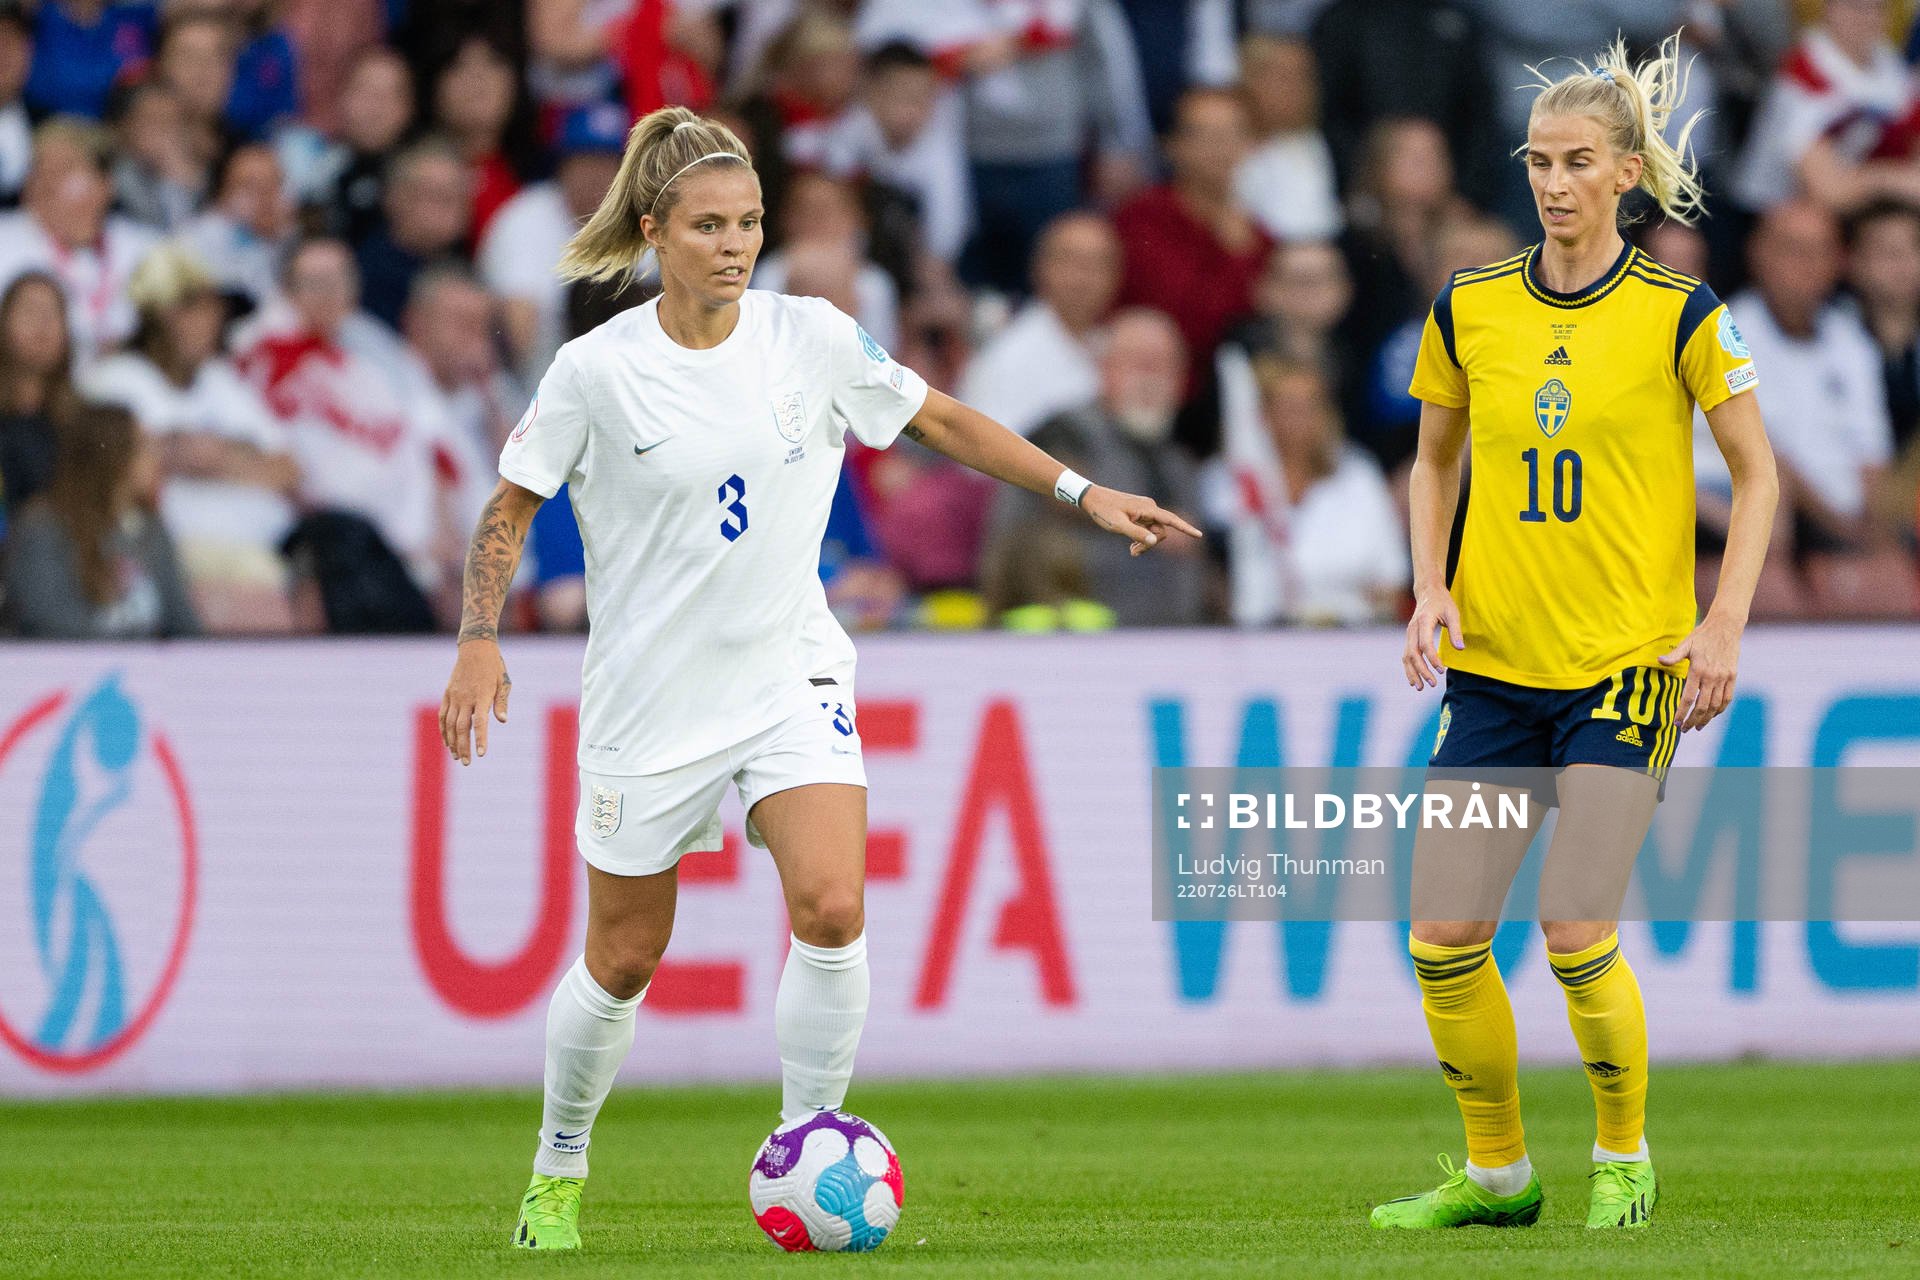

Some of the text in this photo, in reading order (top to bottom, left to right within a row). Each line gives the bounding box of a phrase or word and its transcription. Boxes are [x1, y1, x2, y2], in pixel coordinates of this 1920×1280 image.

[1544, 358, 1572, 366] adidas
[718, 473, 749, 542] 3
[1519, 447, 1583, 523] 10
[1591, 666, 1661, 725] 10
[1615, 733, 1644, 748] adidas
